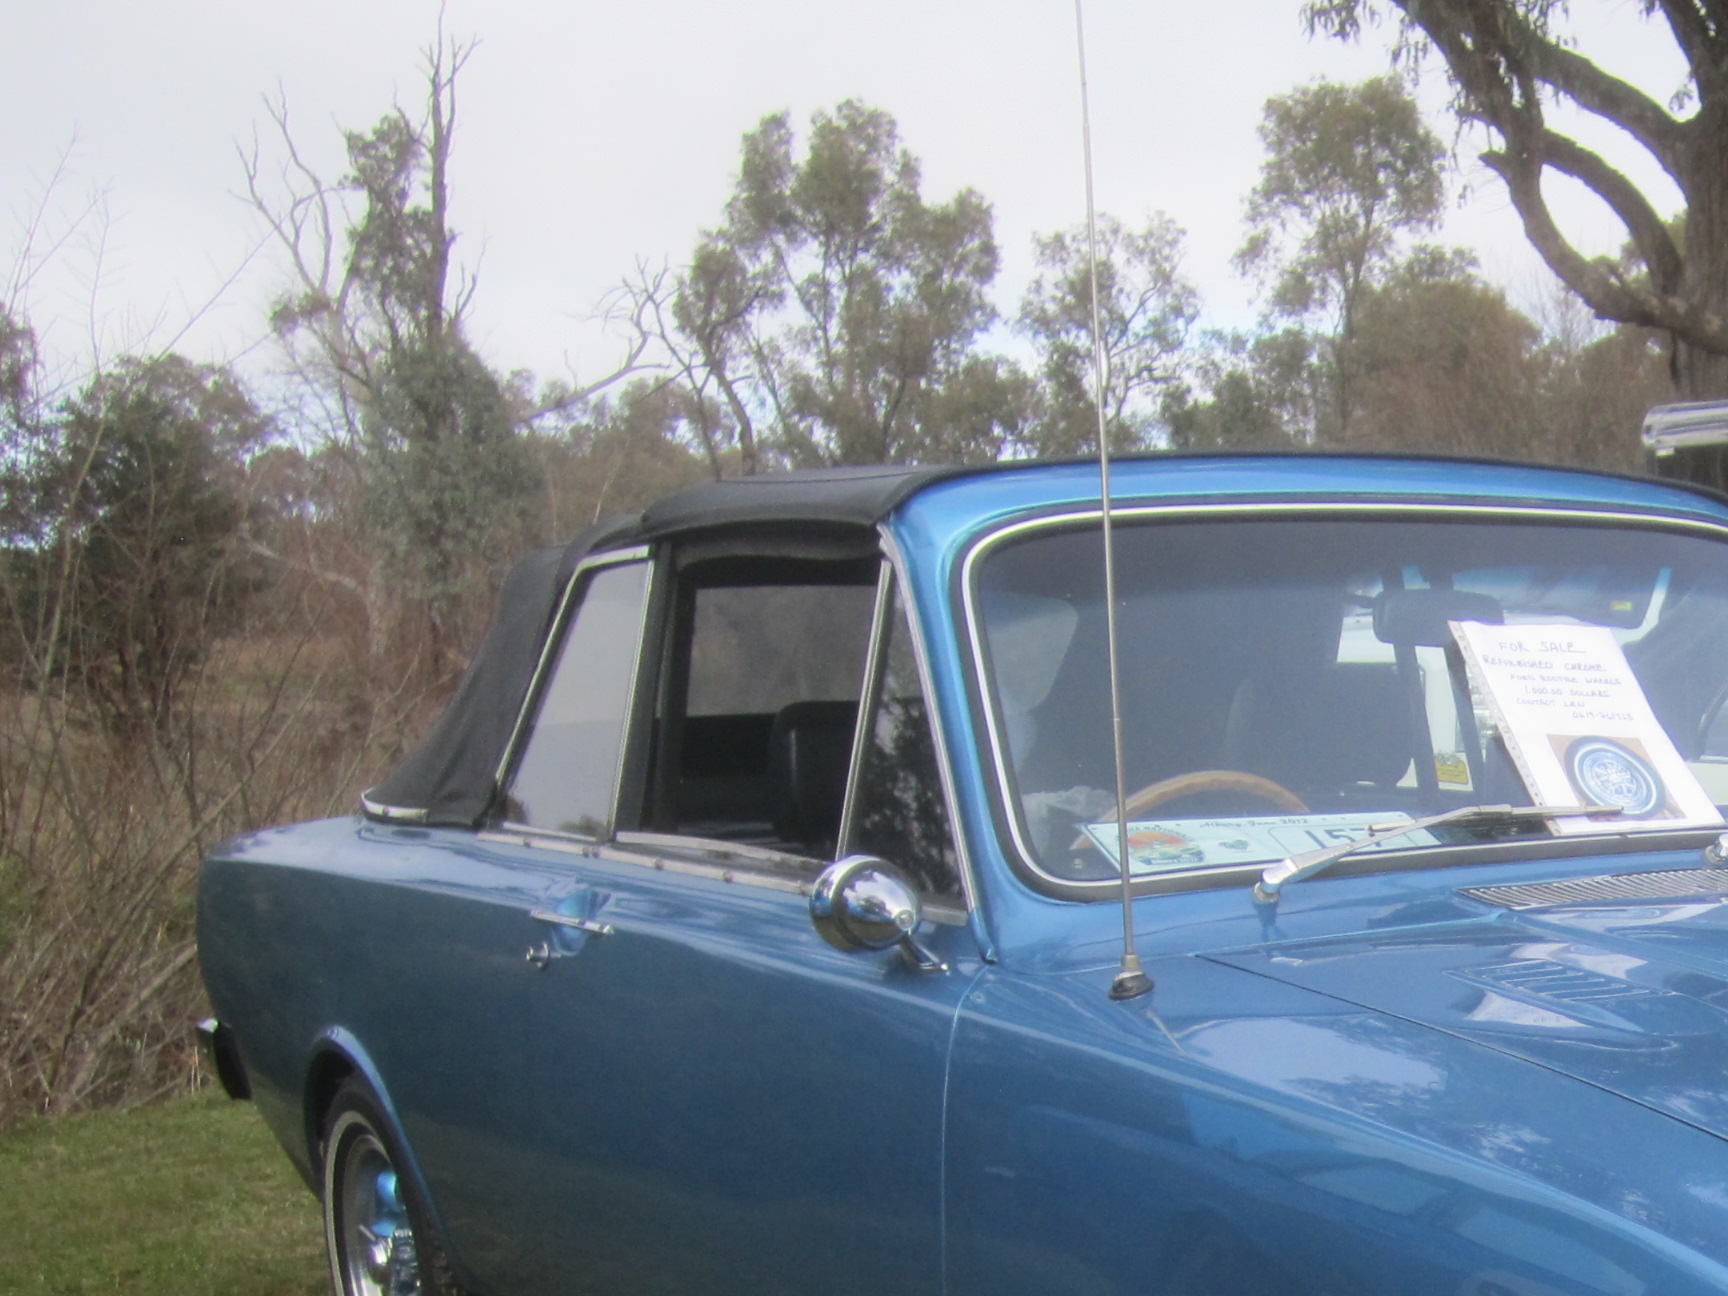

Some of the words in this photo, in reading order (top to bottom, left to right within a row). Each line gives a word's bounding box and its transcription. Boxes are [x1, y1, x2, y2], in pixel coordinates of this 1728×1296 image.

[1498, 641, 1529, 653] FOR
[1539, 641, 1586, 654] SALE
[1564, 662, 1607, 673] CHROME
[1570, 689, 1611, 698] DOLLARS
[1516, 697, 1556, 707] CONTACT
